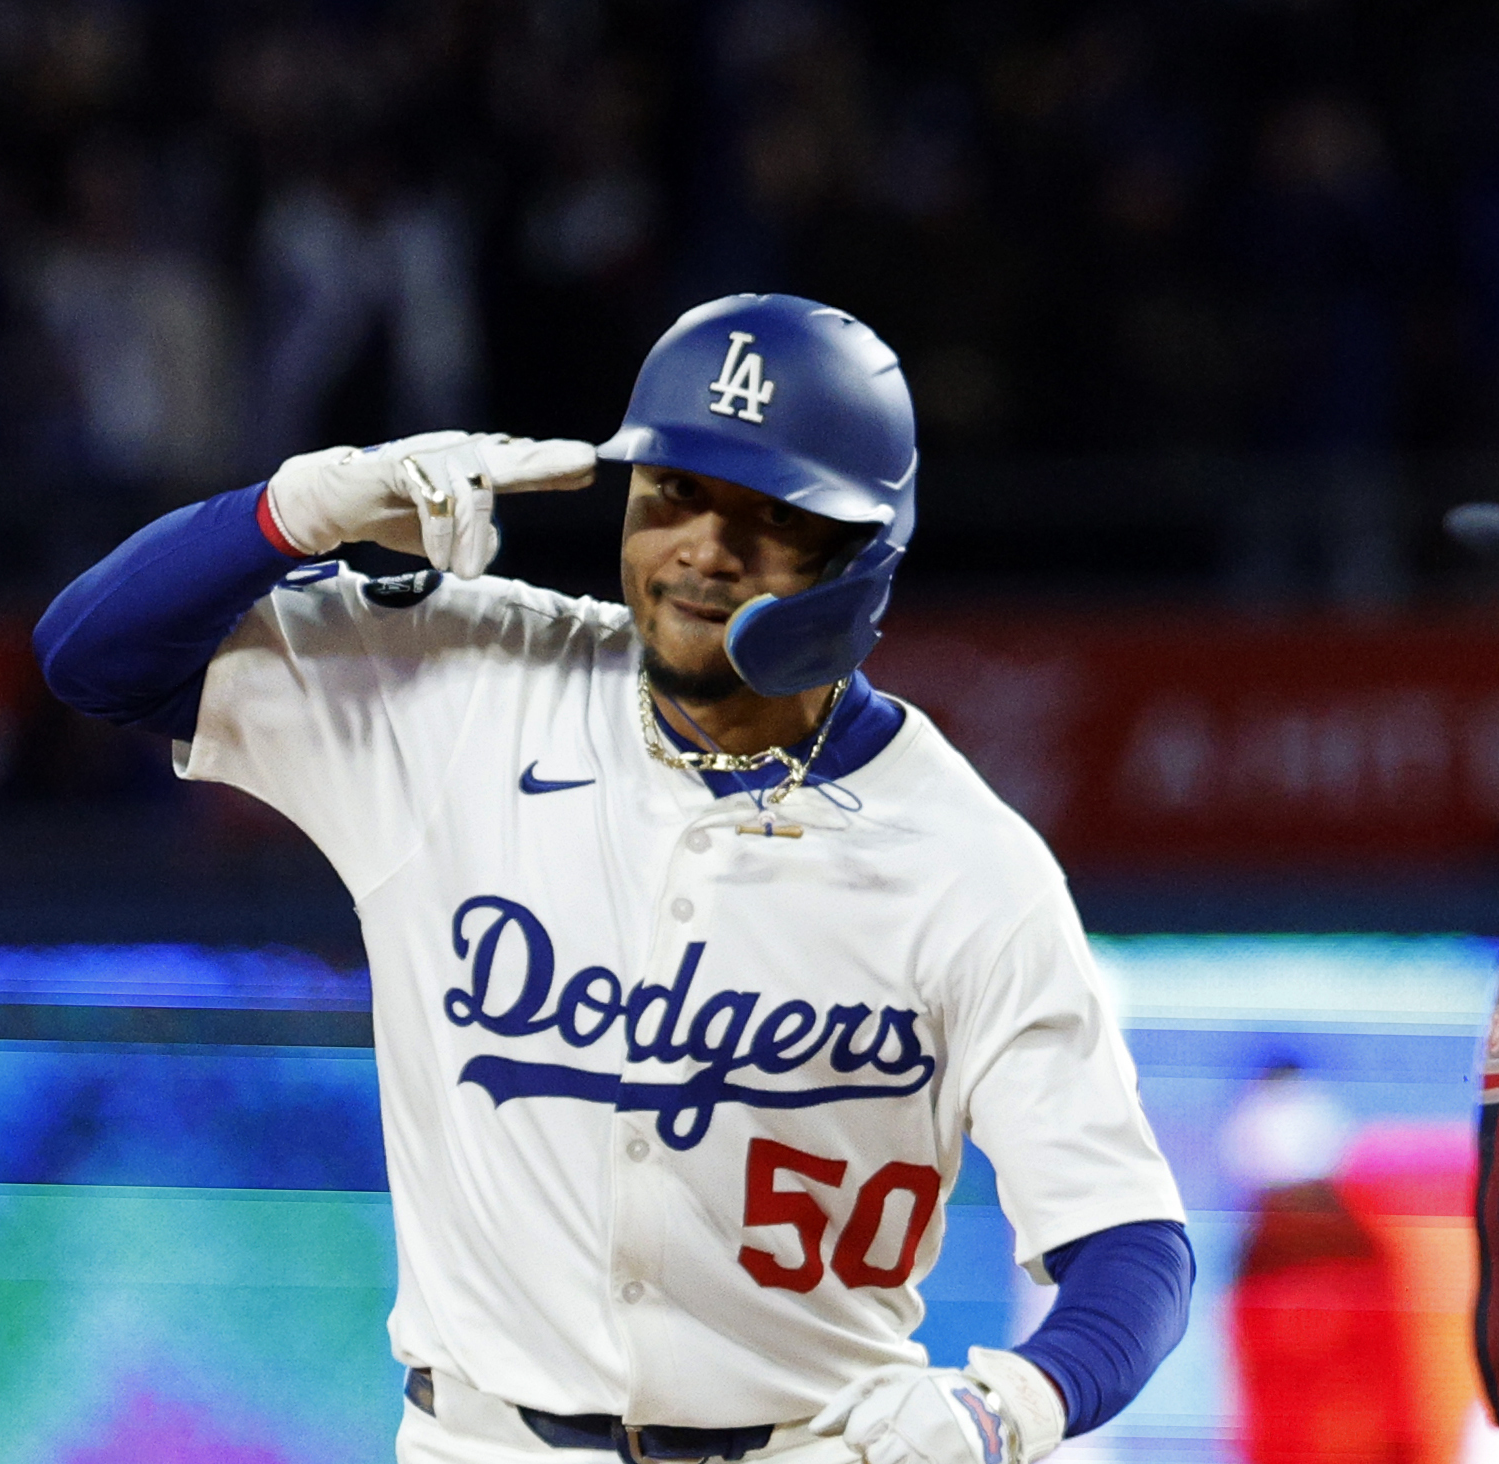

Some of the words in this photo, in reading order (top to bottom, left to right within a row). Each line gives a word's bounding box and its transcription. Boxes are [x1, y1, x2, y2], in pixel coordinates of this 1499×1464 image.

[709, 330, 775, 424] LA
[443, 894, 936, 1151] Dodgers
[737, 1137, 942, 1294] 50
